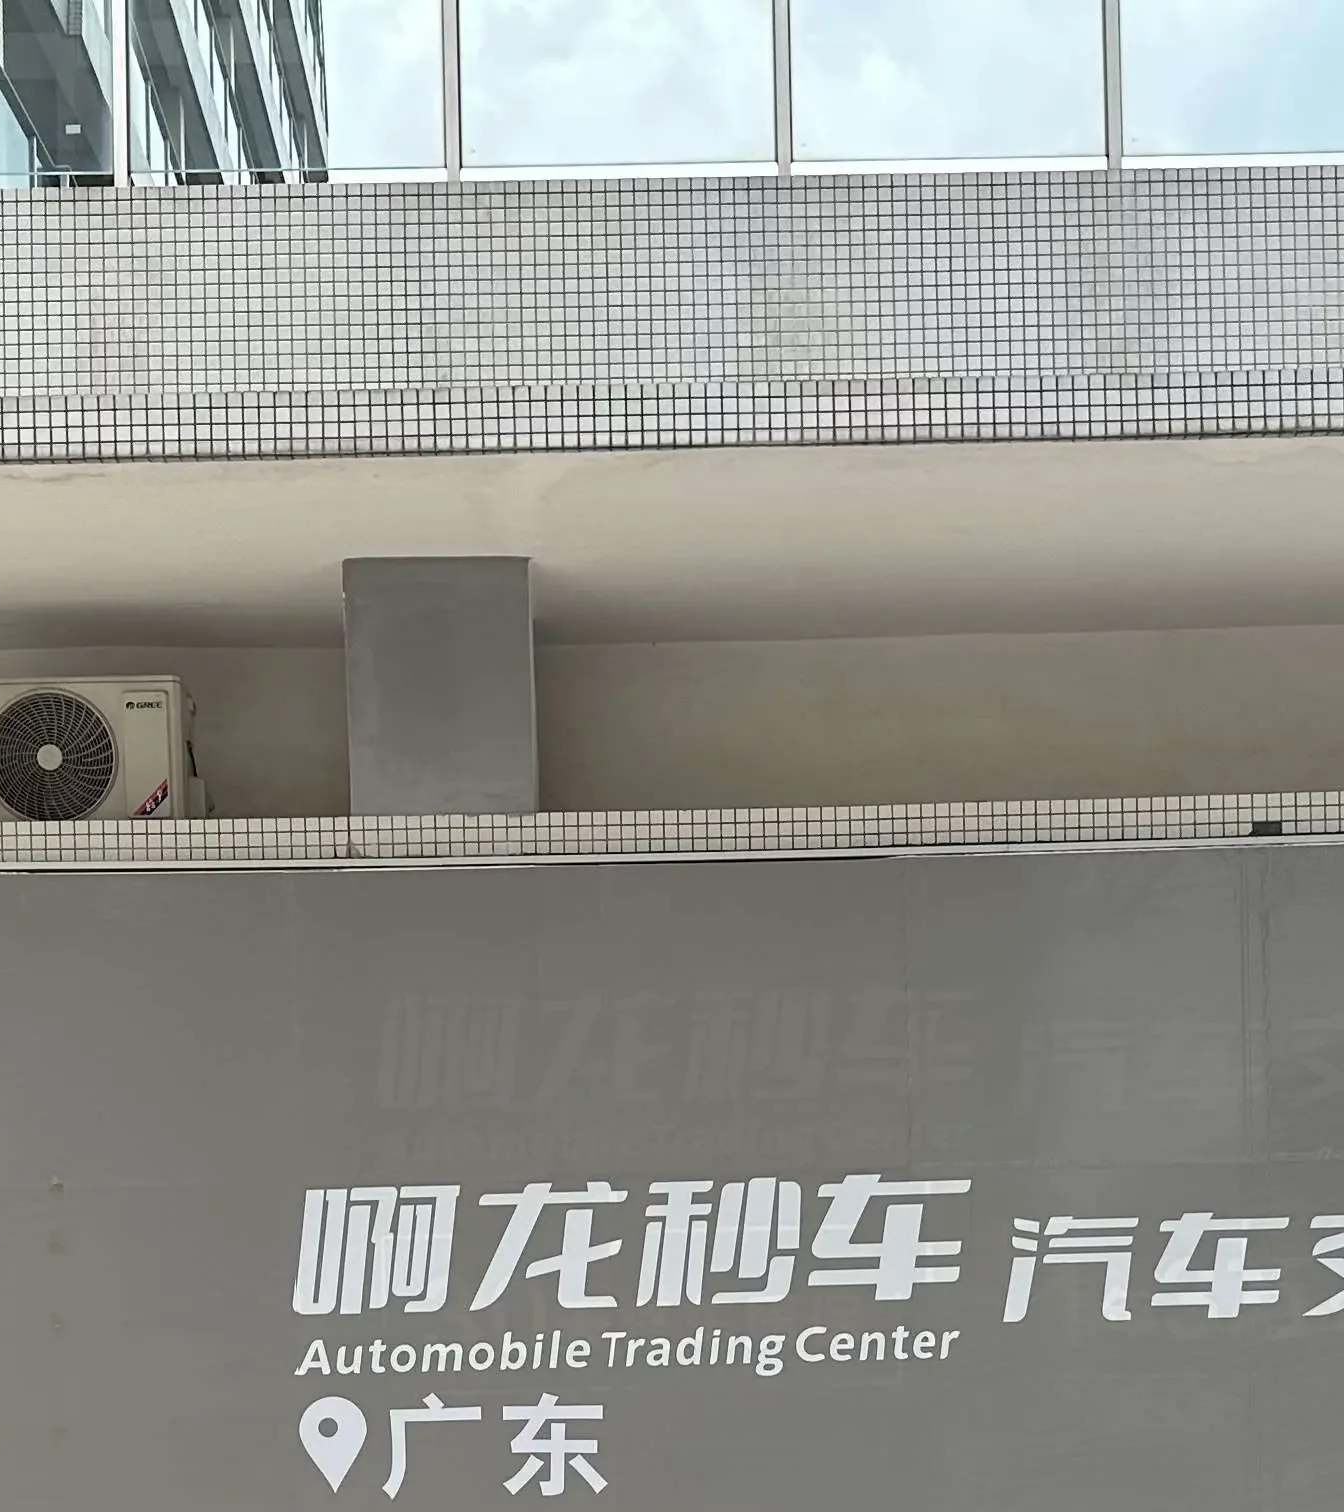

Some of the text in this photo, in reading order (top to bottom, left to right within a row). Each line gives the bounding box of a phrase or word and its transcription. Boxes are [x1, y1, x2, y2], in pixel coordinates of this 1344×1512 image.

[294, 1176, 973, 1315] 啊龙秒车
[295, 1326, 962, 1378] Automobile Trading Center
[381, 1393, 609, 1500] 广东
